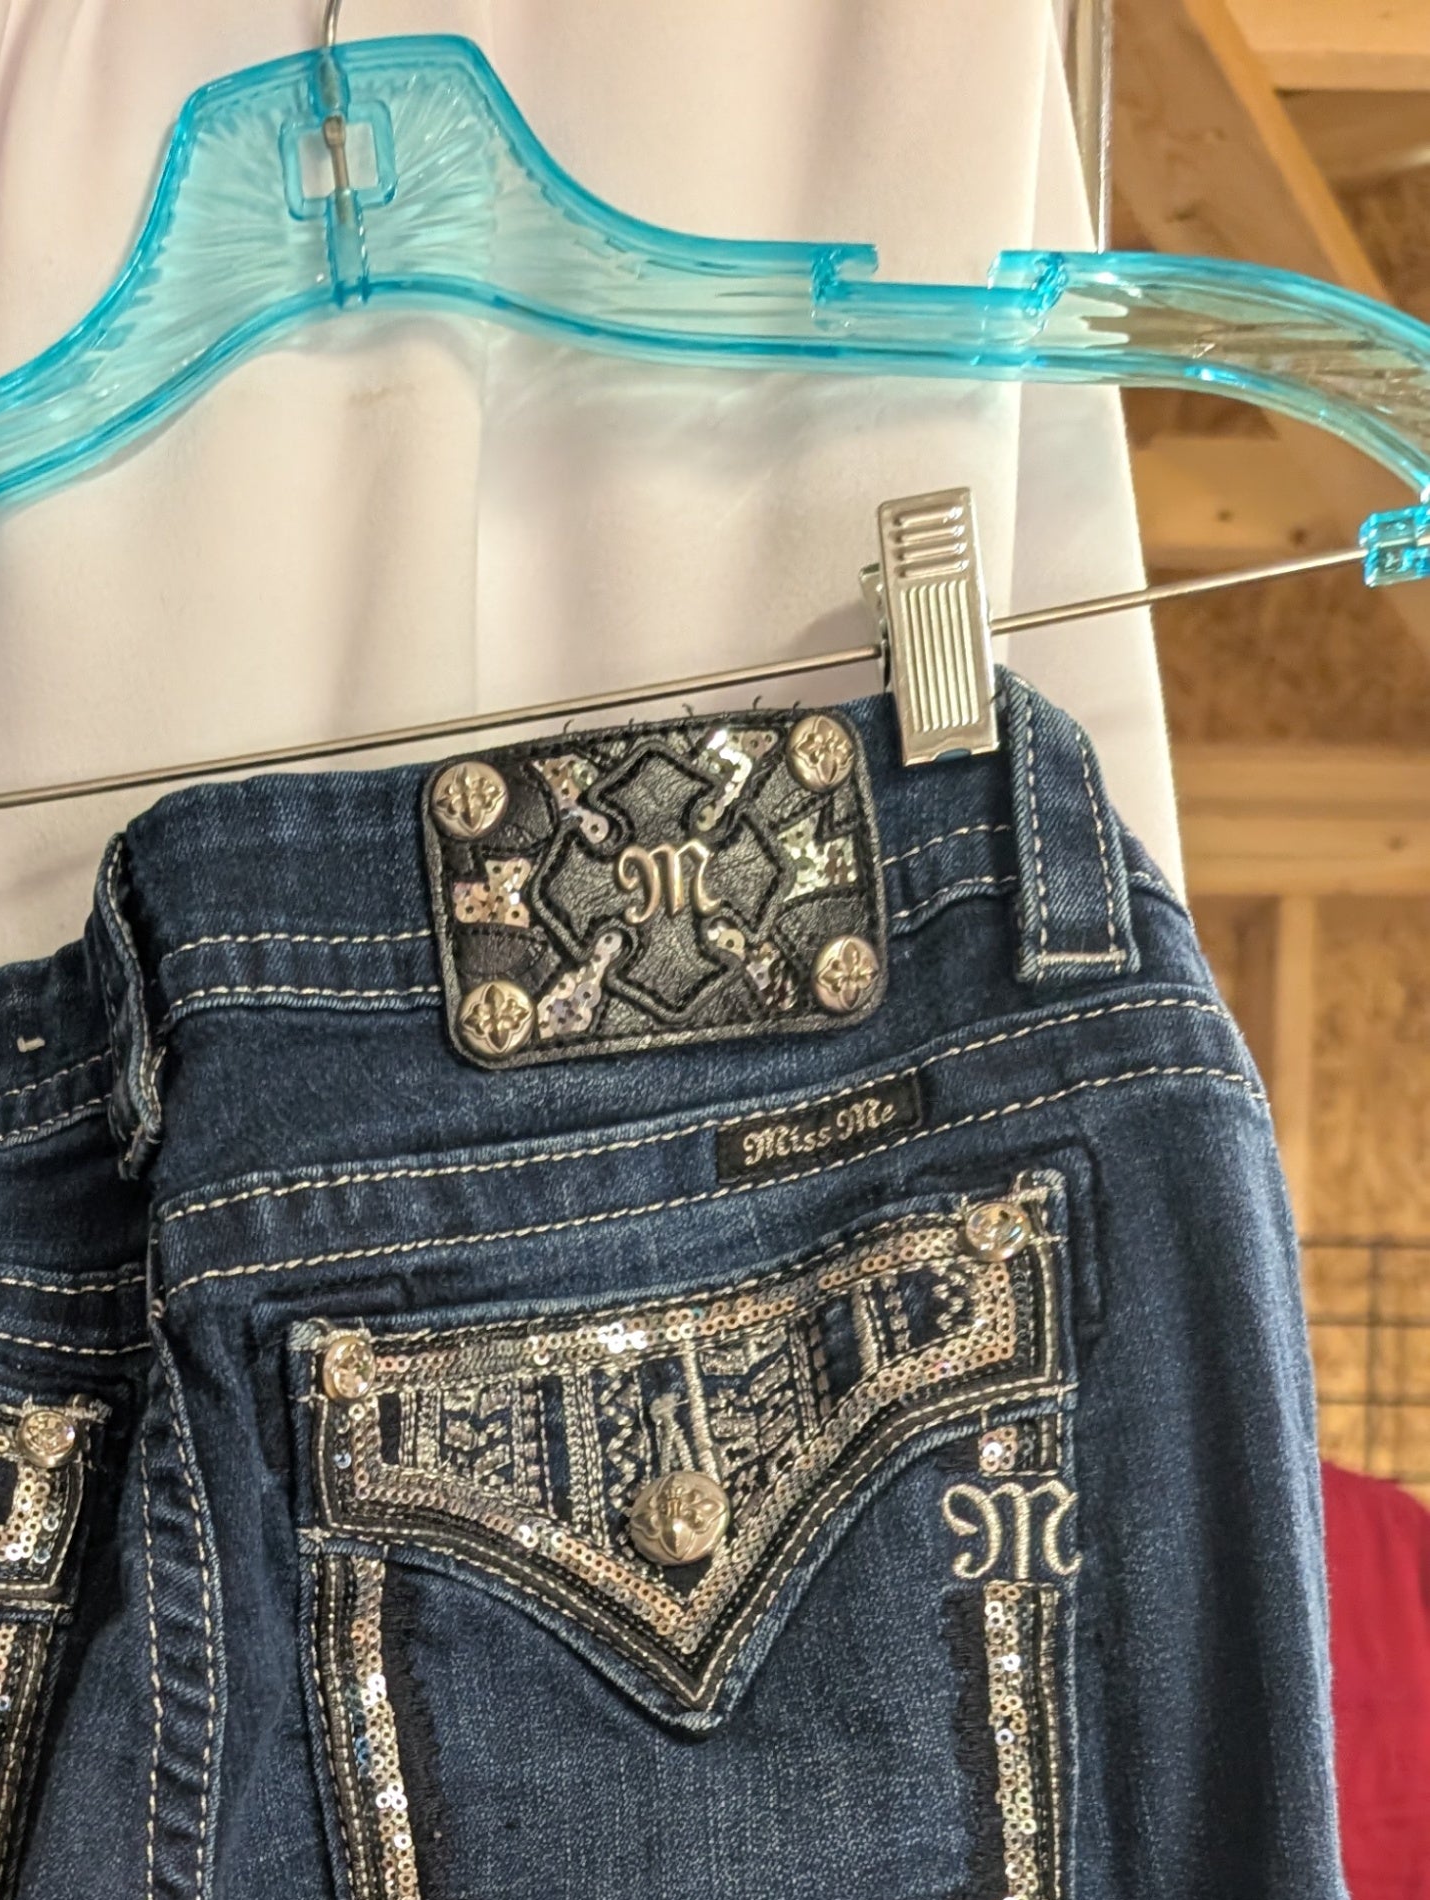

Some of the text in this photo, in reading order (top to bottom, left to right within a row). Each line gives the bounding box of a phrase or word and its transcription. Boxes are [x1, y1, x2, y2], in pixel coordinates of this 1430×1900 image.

[742, 1098, 897, 1167] Miss Me
[941, 1479, 1084, 1580] M
